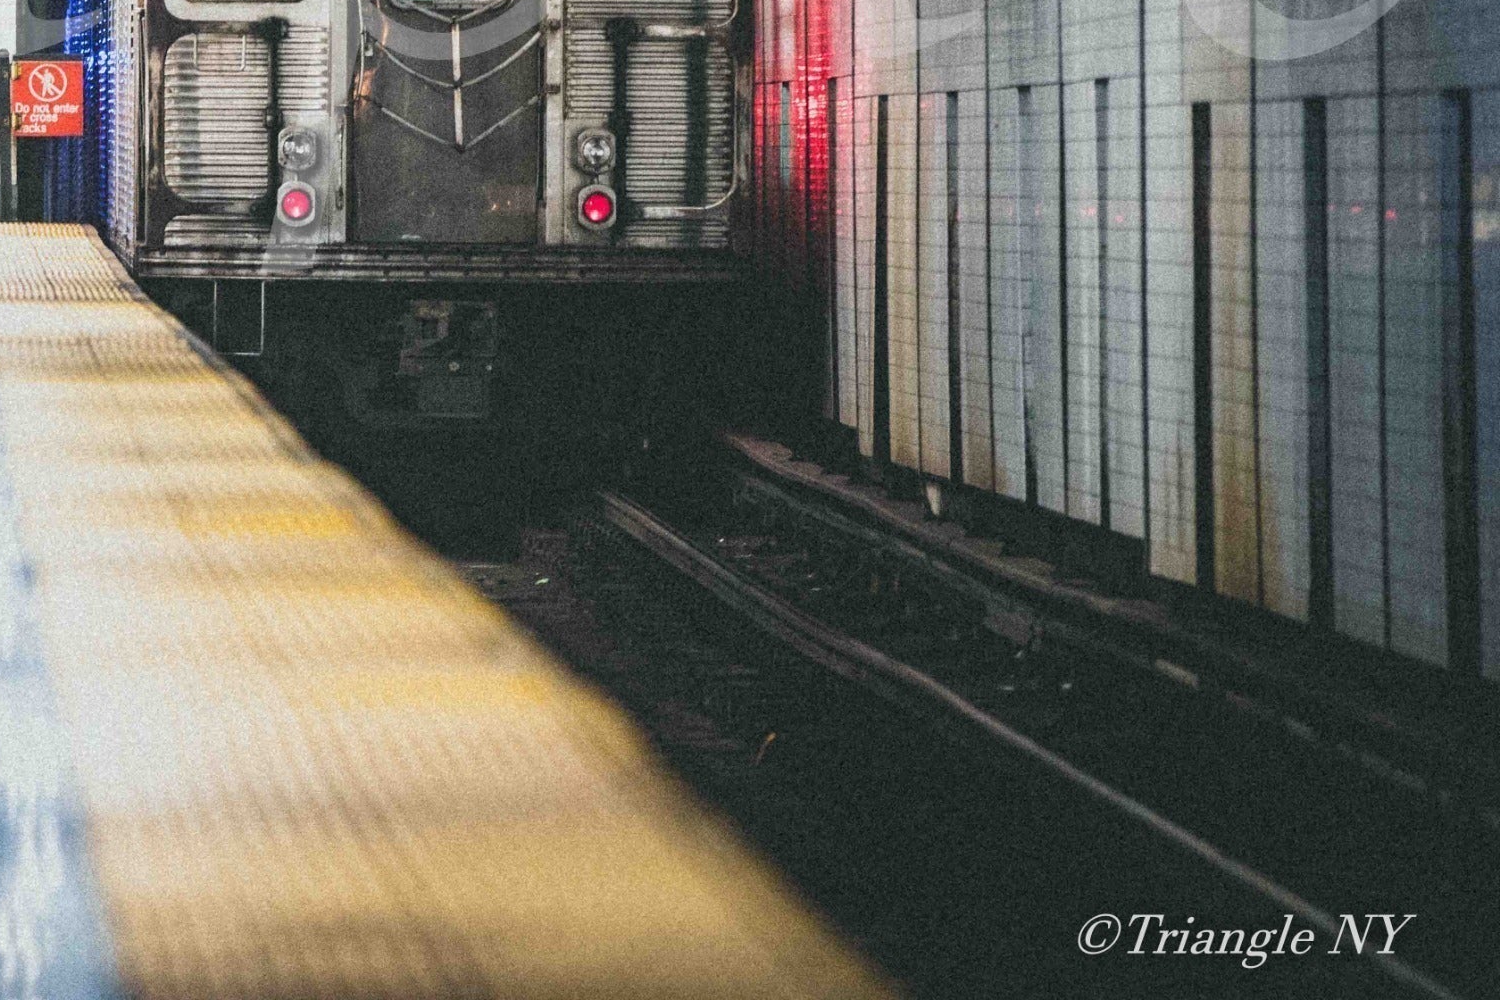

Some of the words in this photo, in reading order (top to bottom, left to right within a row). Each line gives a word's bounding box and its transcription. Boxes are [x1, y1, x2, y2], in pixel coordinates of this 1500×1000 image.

[15, 102, 30, 113] Do
[33, 103, 50, 113] not
[53, 103, 79, 113] enter
[30, 113, 58, 123] cross
